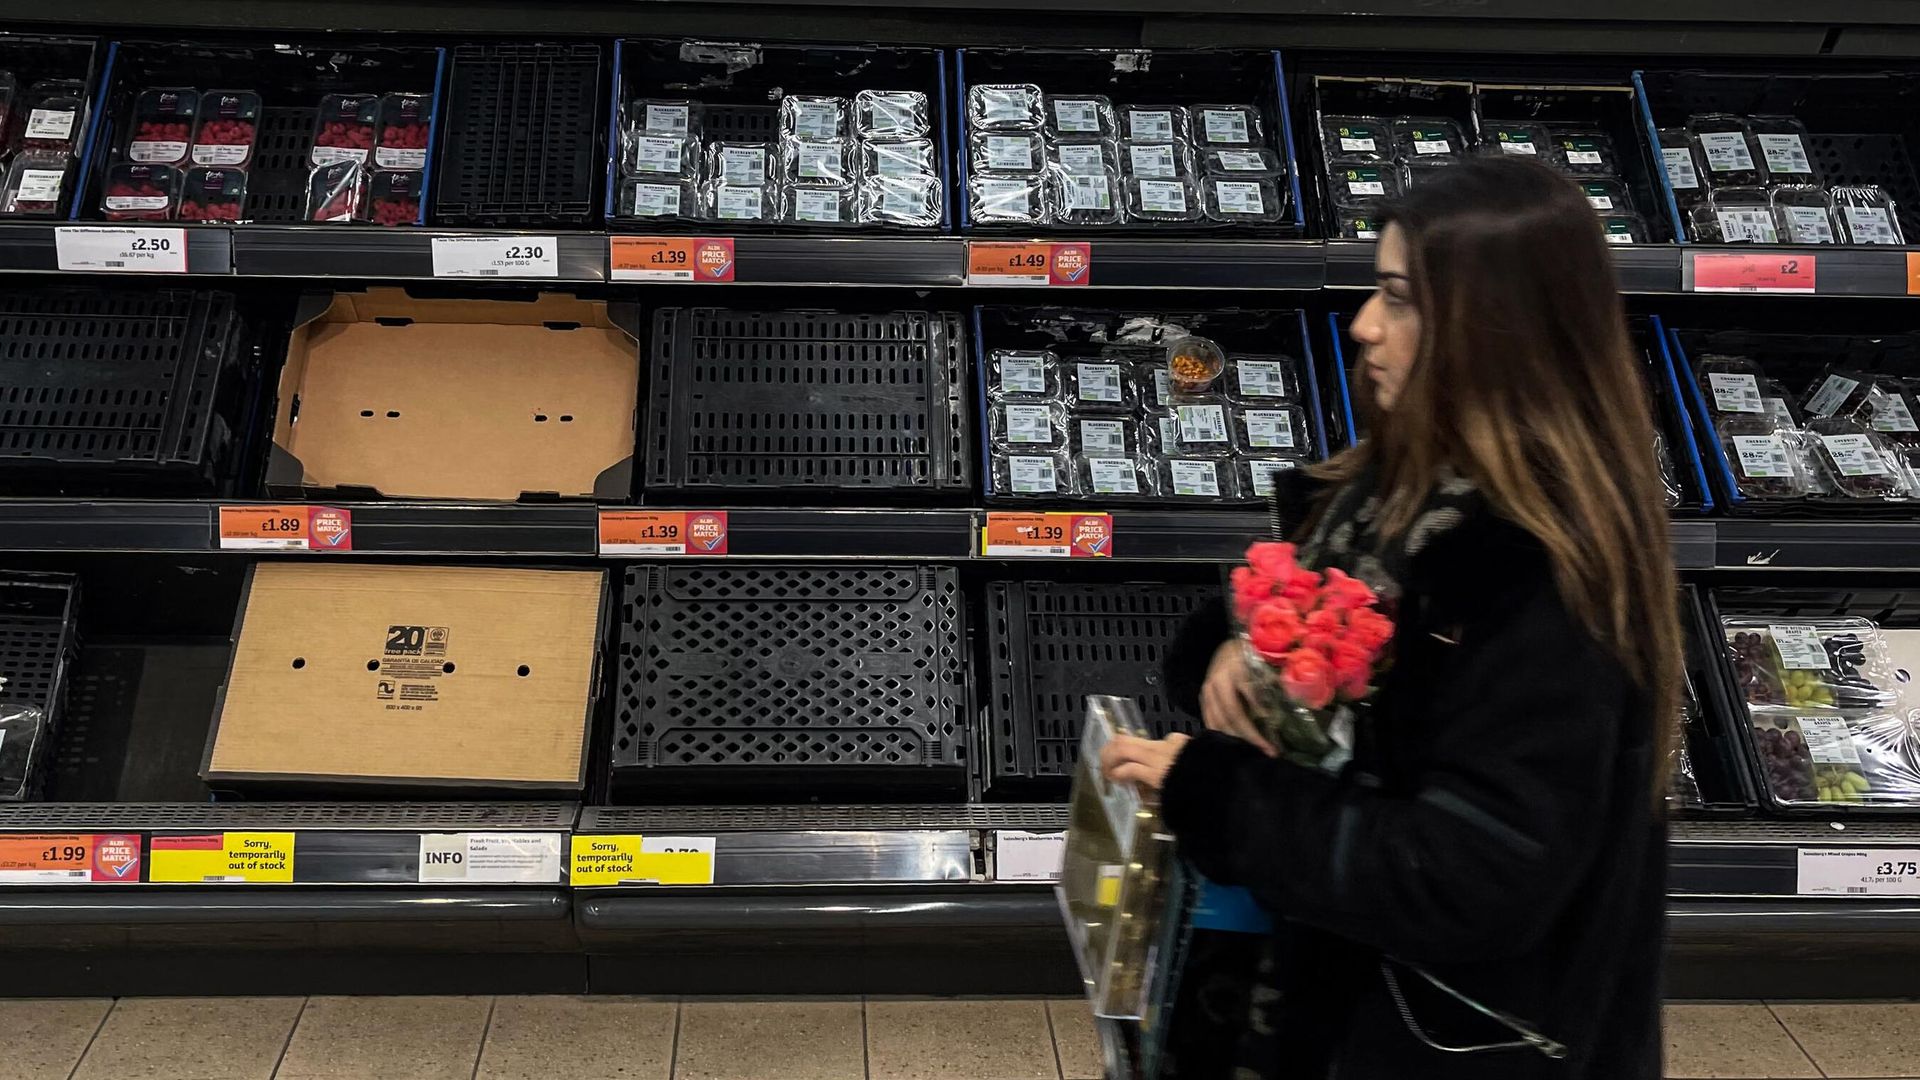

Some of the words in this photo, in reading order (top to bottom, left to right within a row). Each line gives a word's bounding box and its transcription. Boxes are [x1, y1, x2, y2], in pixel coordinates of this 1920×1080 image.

[132, 238, 170, 250] £2.50
[506, 247, 542, 258] £2.30
[652, 251, 686, 263] £1.39
[1010, 254, 1044, 266] £1.49
[1781, 261, 1798, 274] £2
[262, 518, 299, 531] £1.89
[642, 525, 678, 538] £1.39
[1027, 526, 1062, 539] £1.39
[244, 839, 272, 849] Sorry,
[591, 842, 619, 852] Sorry,
[42, 846, 85, 861] £1.99
[102, 854, 130, 862] MATCH
[229, 850, 286, 860] temporarily
[425, 852, 462, 864] INFO
[577, 853, 633, 863] temporarily
[248, 861, 257, 869] of
[260, 861, 285, 869] stock
[576, 865, 592, 873] out
[595, 864, 604, 872] of
[608, 863, 632, 872] stock
[1877, 862, 1917, 875] £3.75
